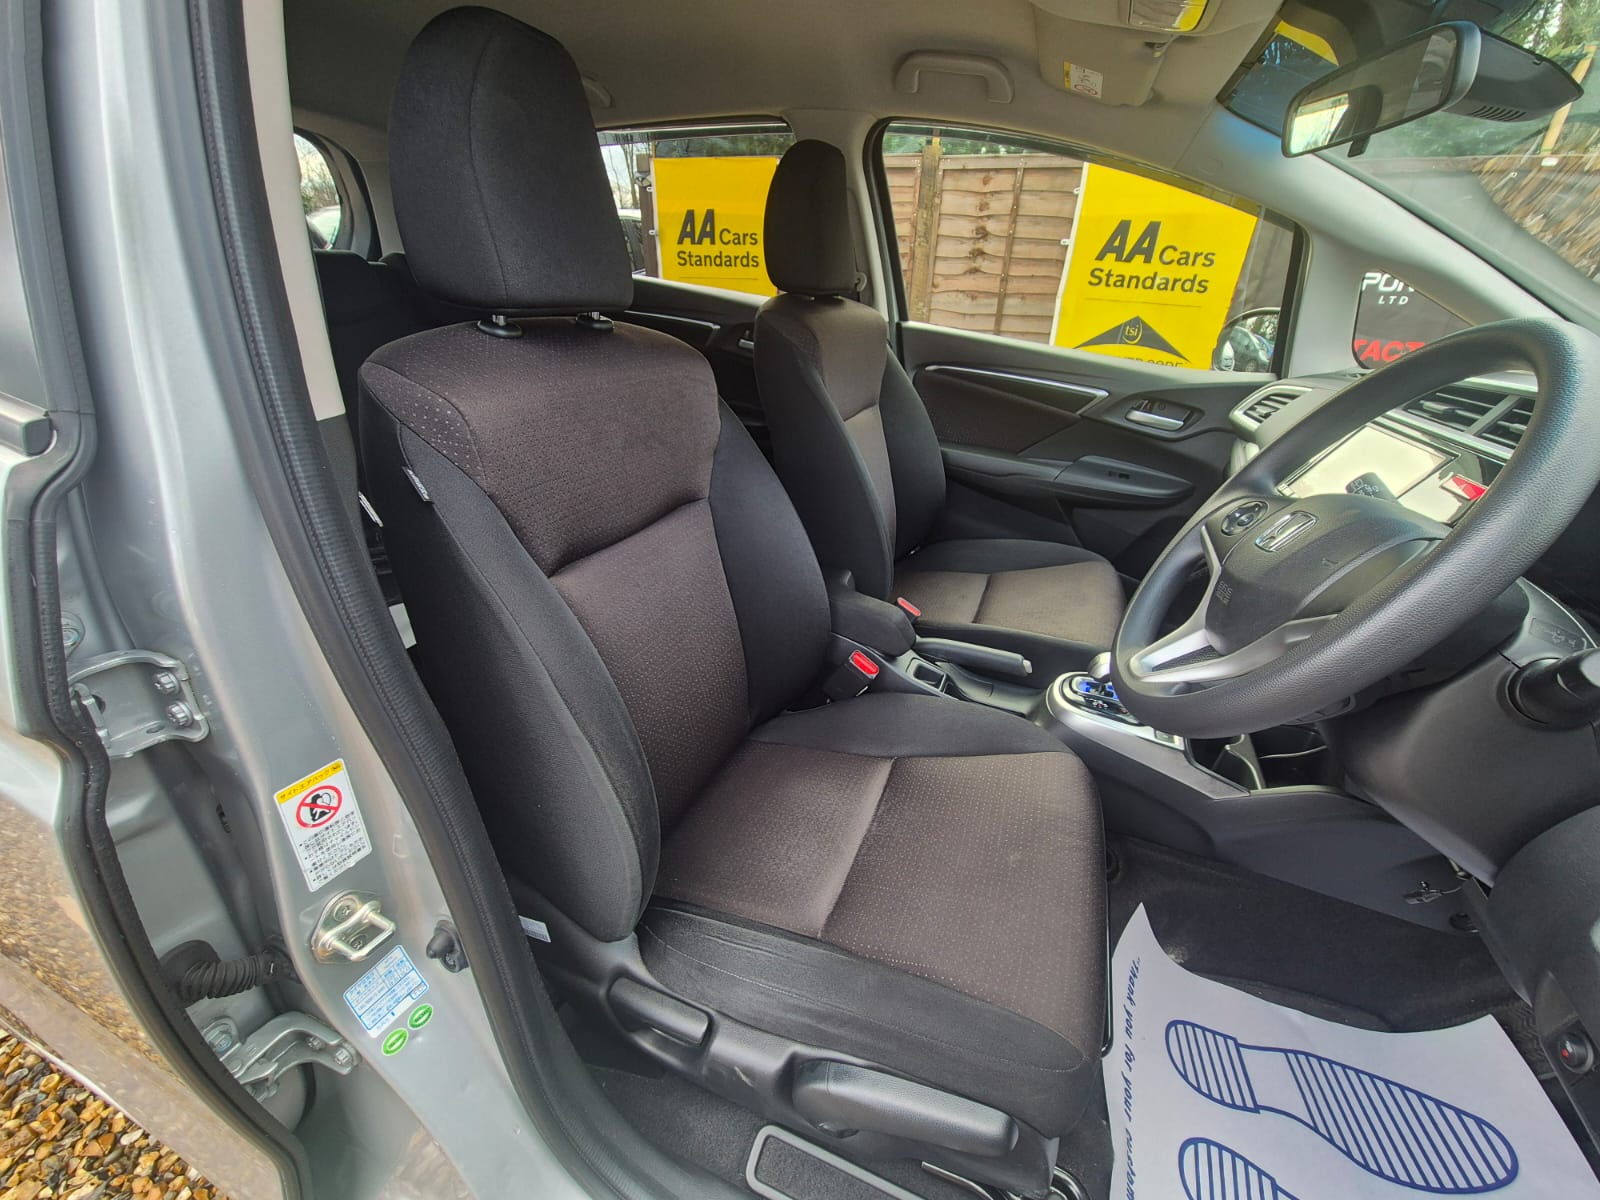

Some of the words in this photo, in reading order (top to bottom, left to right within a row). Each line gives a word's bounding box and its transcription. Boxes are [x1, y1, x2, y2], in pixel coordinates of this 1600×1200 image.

[677, 209, 716, 245] AA
[719, 228, 758, 246] Cars
[1094, 219, 1162, 264] AA
[1158, 245, 1216, 268] Cars
[677, 250, 760, 268] Standards
[1087, 267, 1209, 294] Standards
[1122, 1003, 1134, 1040] you
[1124, 1043, 1136, 1073] for
[1121, 1071, 1134, 1122] your
